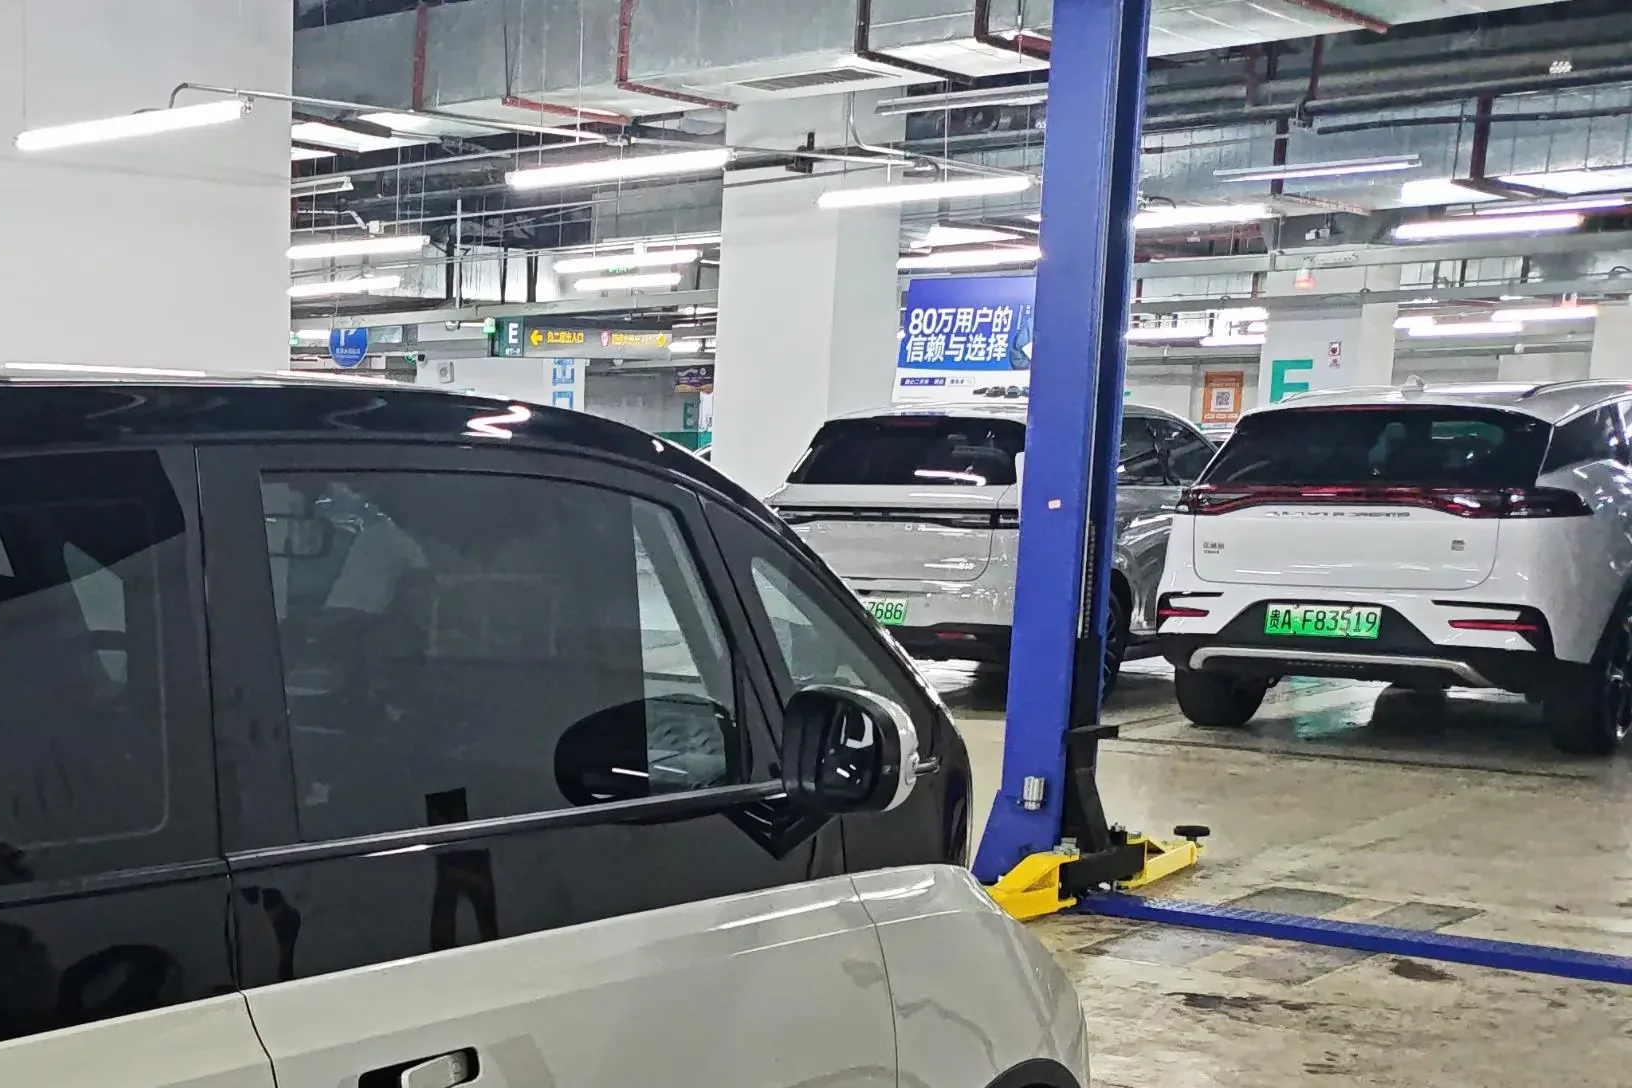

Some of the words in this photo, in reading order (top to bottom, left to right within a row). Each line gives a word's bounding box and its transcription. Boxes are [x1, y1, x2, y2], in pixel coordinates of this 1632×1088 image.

[508, 322, 519, 344] E
[908, 305, 1013, 335] 80万用户的
[906, 333, 1009, 362] 信赖与选择
